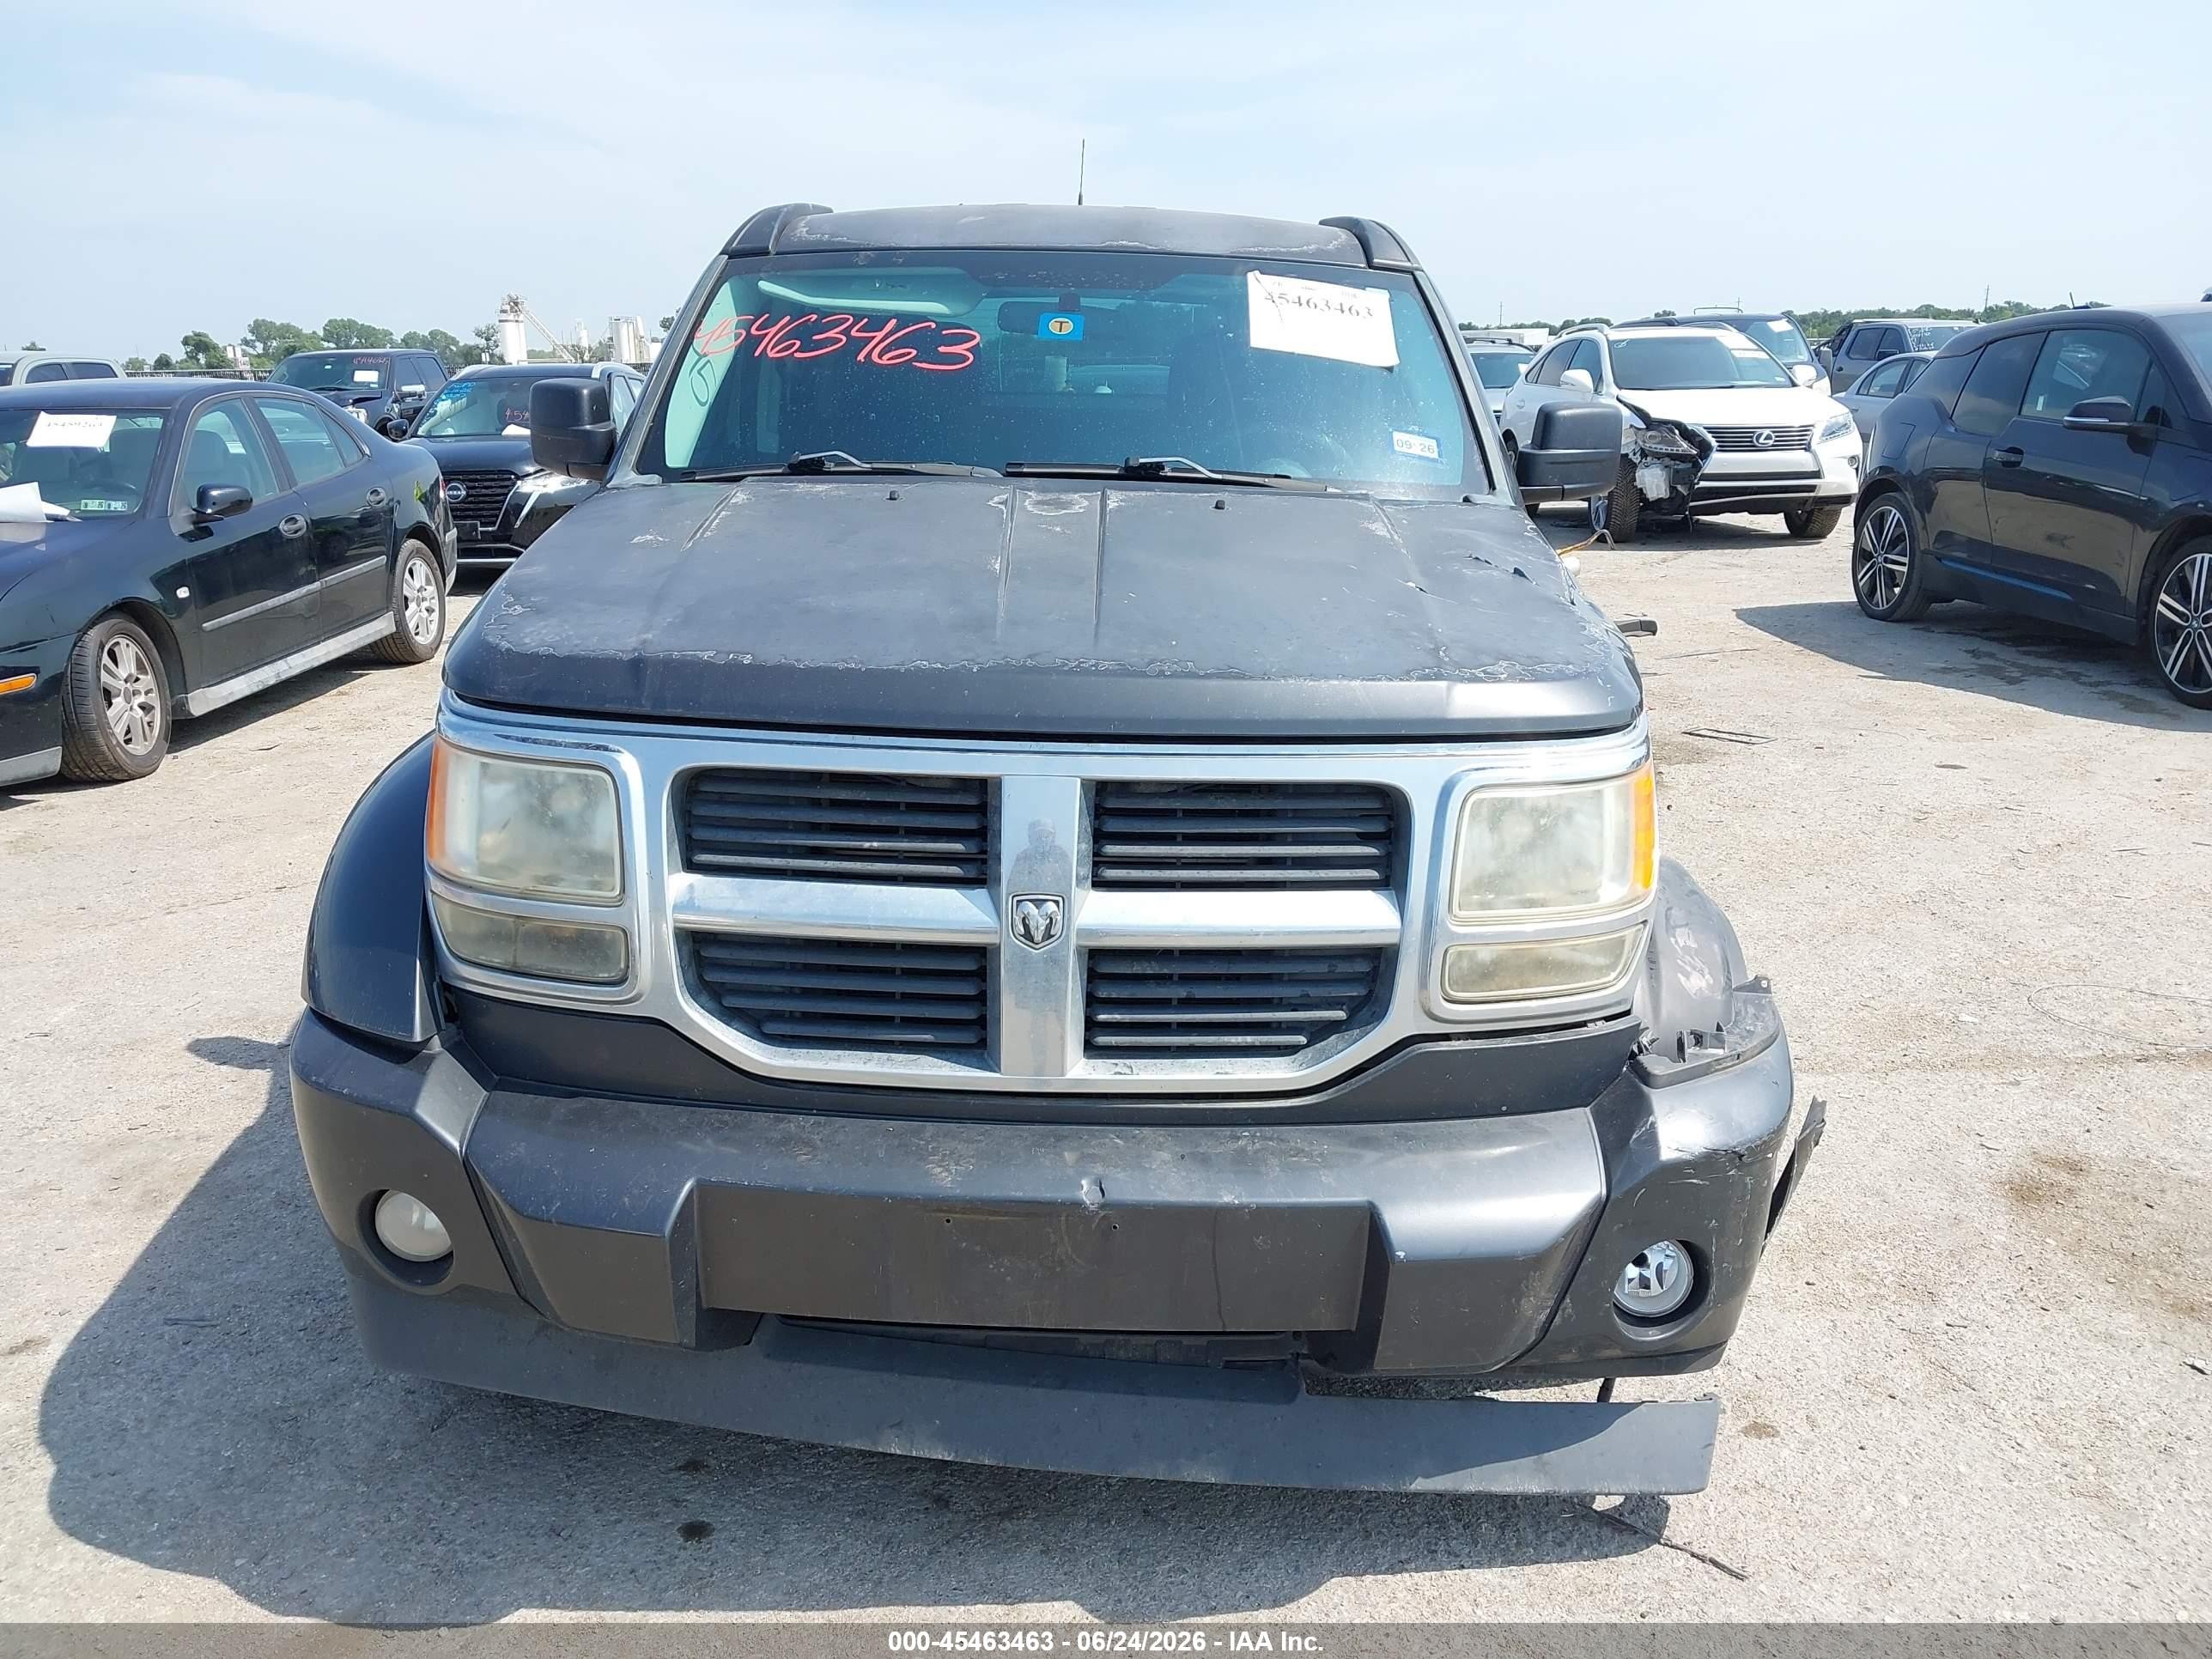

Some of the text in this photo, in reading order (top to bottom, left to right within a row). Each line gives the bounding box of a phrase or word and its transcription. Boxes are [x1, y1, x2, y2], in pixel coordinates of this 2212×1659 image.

[1264, 291, 1374, 319] 45463463
[1054, 320, 1070, 333] T
[694, 313, 981, 370] 45463463
